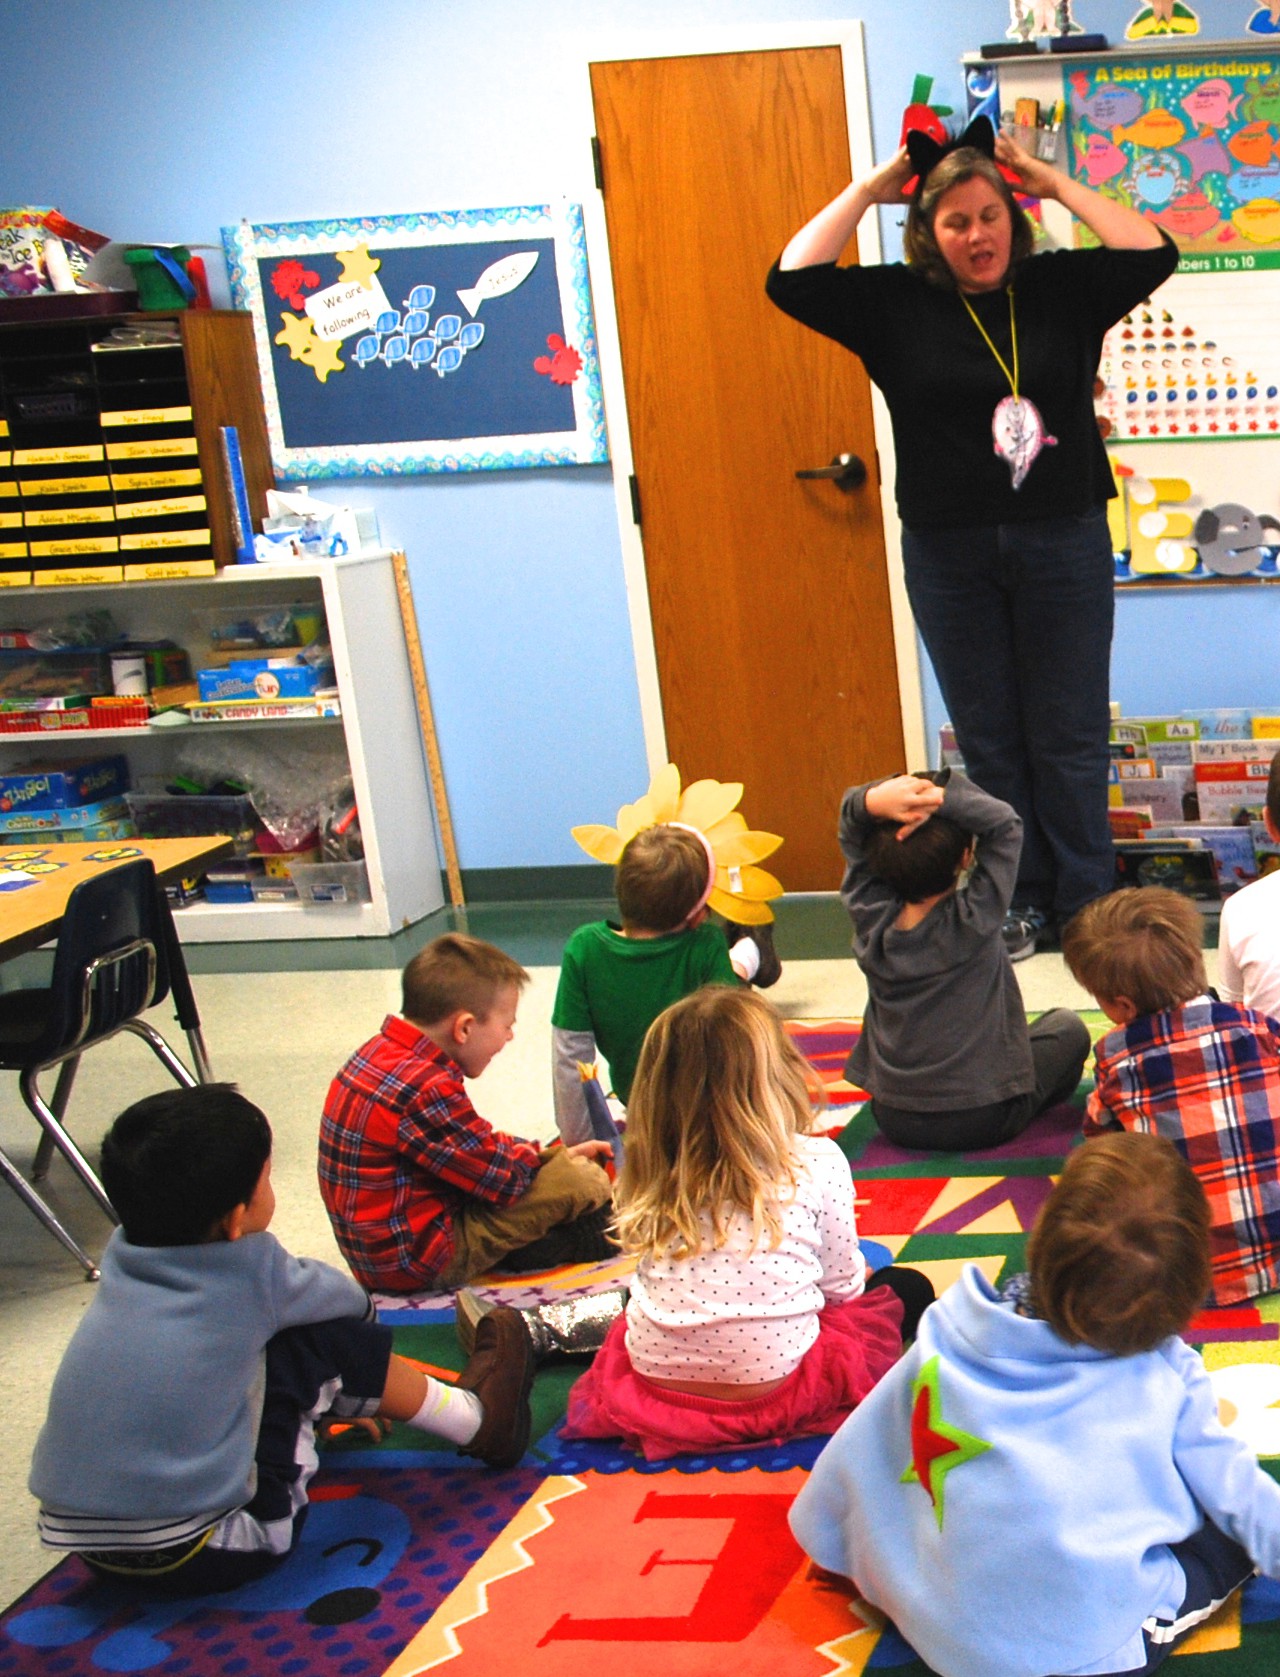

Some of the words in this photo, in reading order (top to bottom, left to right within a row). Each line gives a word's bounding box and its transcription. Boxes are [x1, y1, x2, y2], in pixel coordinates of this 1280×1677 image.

[1095, 66, 1109, 82] A
[1112, 64, 1148, 81] Sea
[1152, 63, 1172, 79] of
[1176, 60, 1272, 80] Birthdays
[1178, 258, 1210, 271] bers
[1224, 256, 1238, 269] to
[1241, 255, 1255, 269] 10
[323, 295, 342, 309] We
[345, 286, 363, 299] are
[323, 308, 371, 336] following
[225, 707, 259, 718] CANDY
[262, 706, 288, 717] LAND
[1172, 724, 1189, 735] Aa
